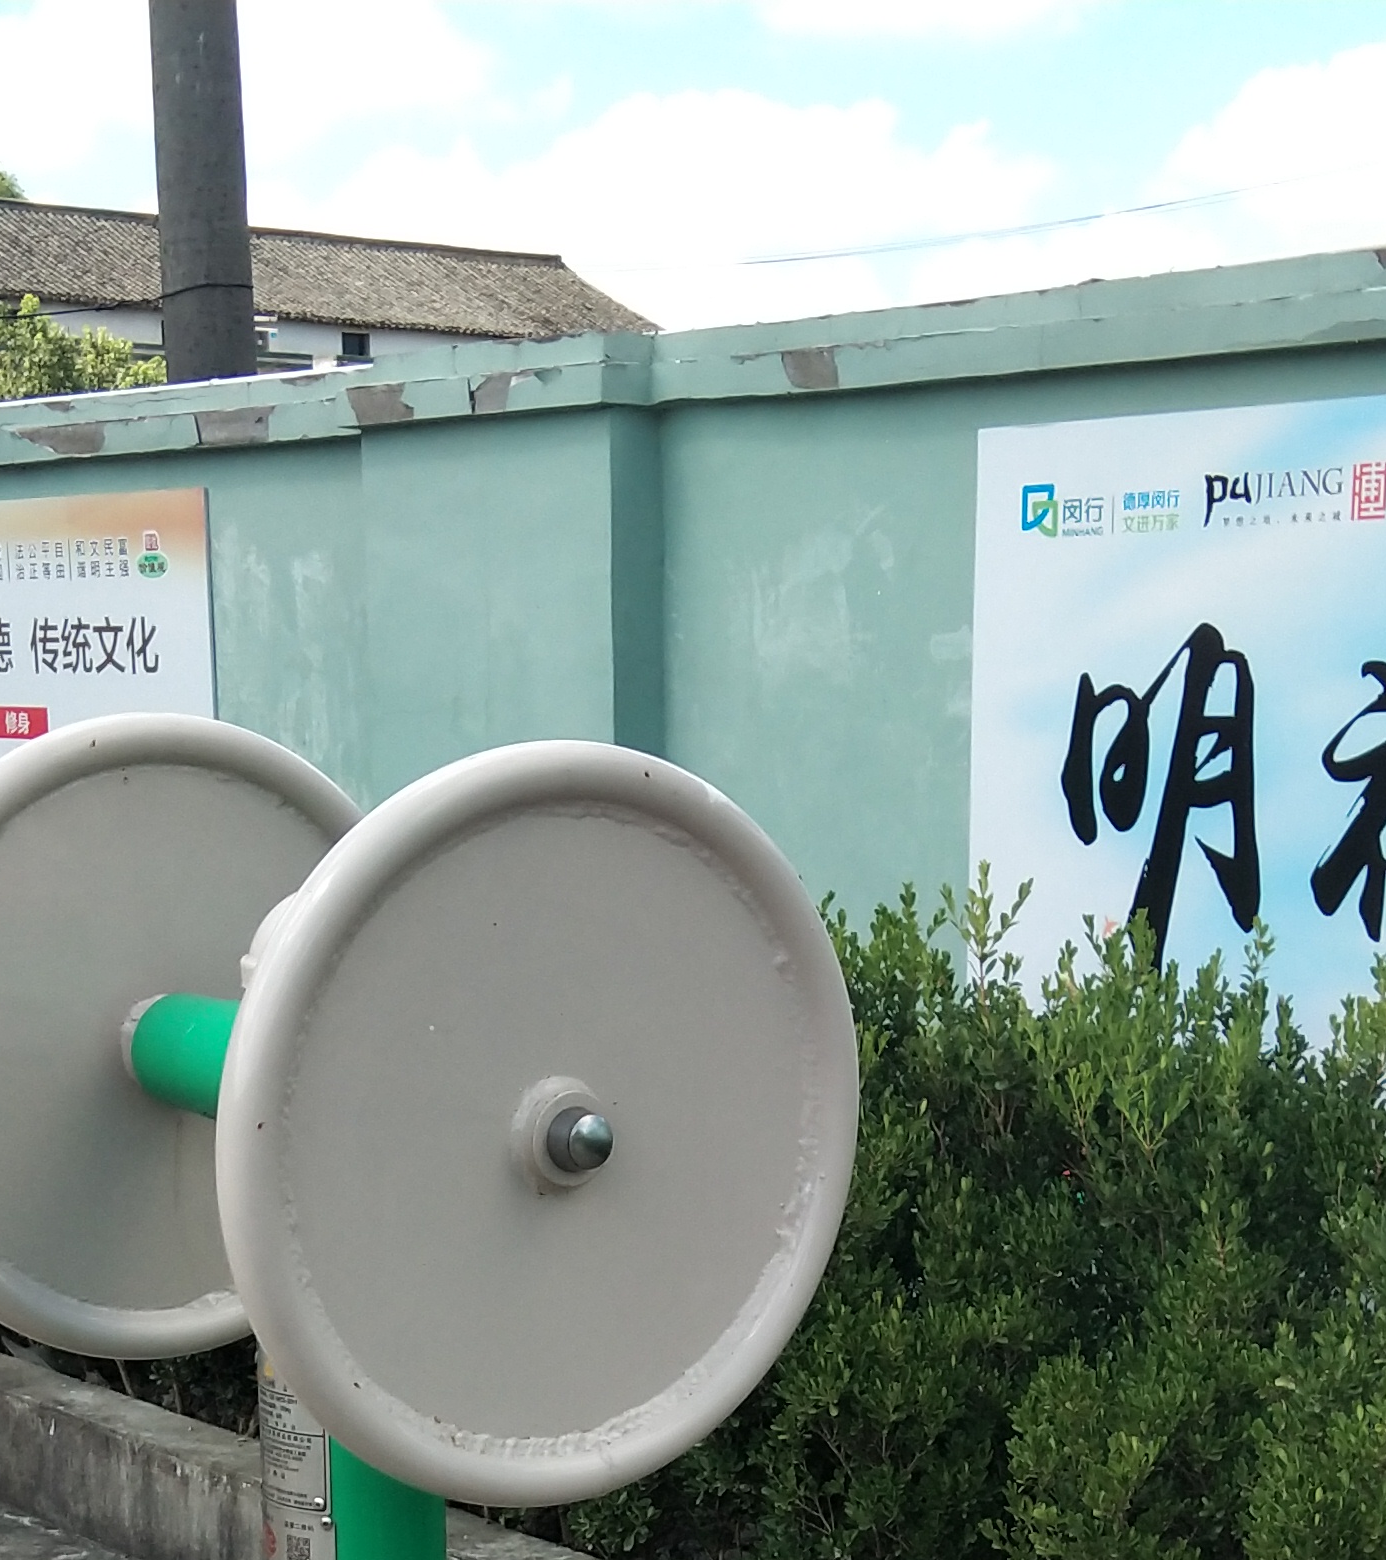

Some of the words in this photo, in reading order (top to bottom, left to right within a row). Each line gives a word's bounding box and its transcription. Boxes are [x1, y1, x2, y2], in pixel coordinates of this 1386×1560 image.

[1063, 497, 1104, 523] 闵行
[30, 616, 159, 674] 传统文化
[5, 711, 30, 734] 修身
